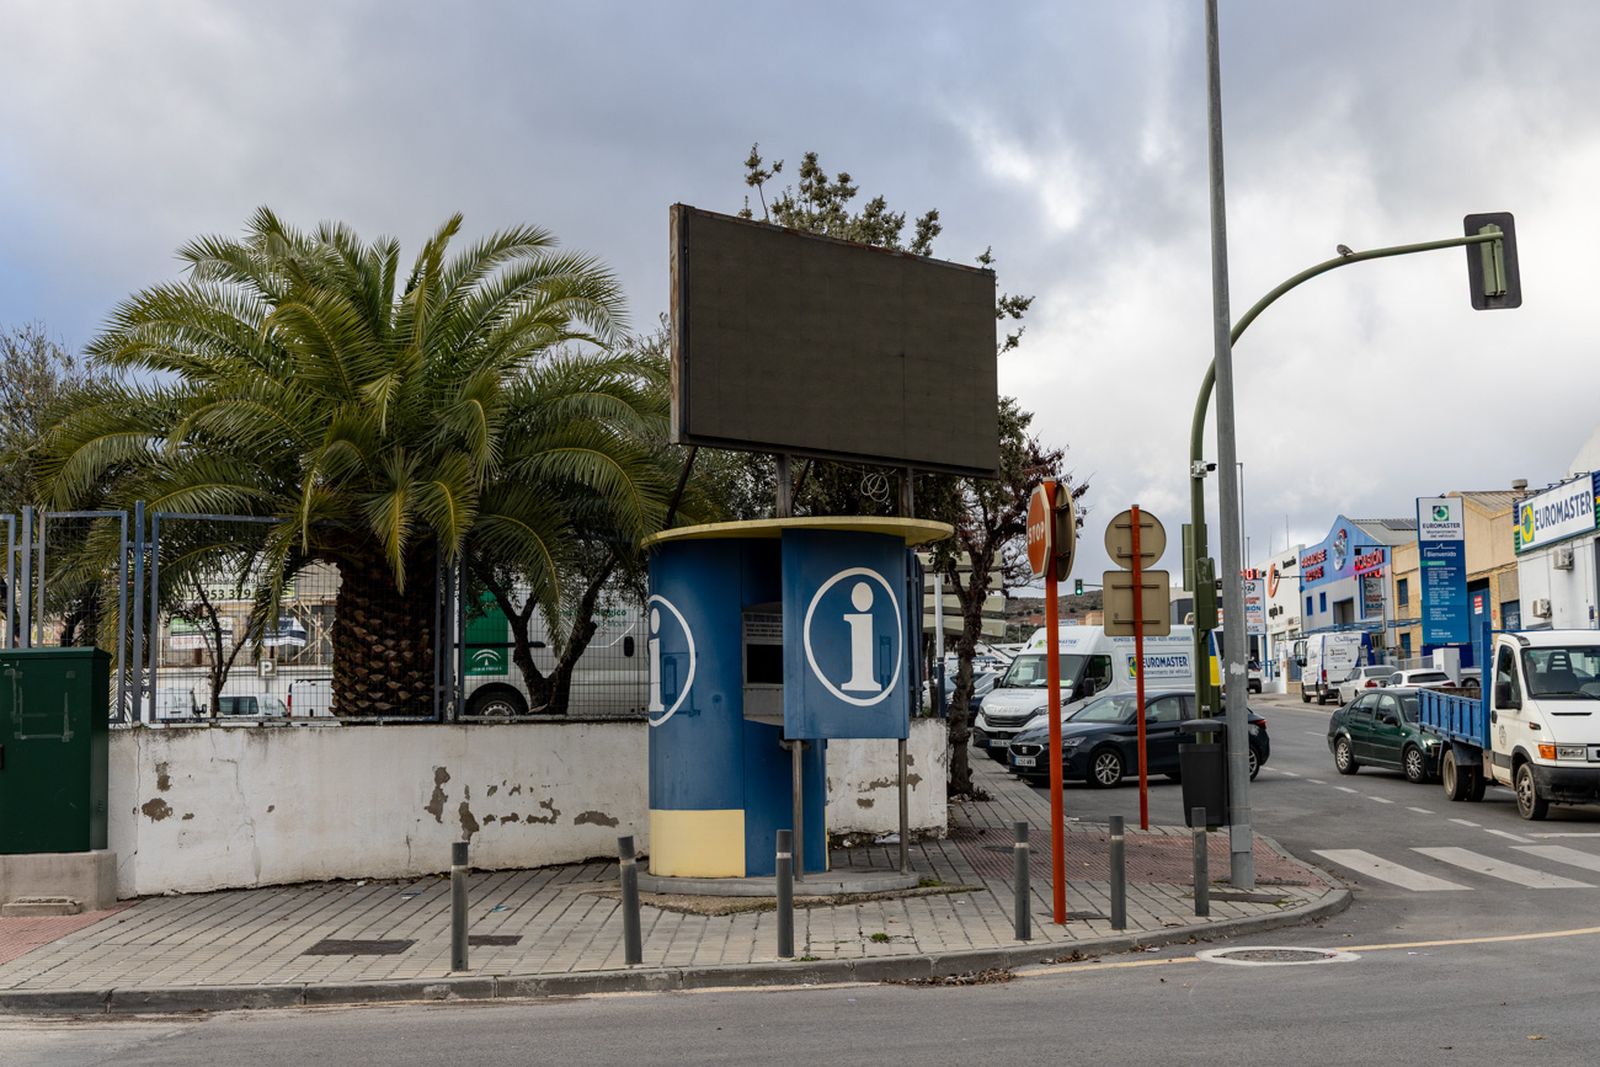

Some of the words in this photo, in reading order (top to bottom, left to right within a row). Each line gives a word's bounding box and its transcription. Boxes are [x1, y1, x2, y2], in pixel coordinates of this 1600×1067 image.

[1535, 490, 1592, 531] EUROMASTER
[1028, 521, 1044, 545] STOP
[228, 588, 251, 600] 39
[260, 662, 273, 676] P
